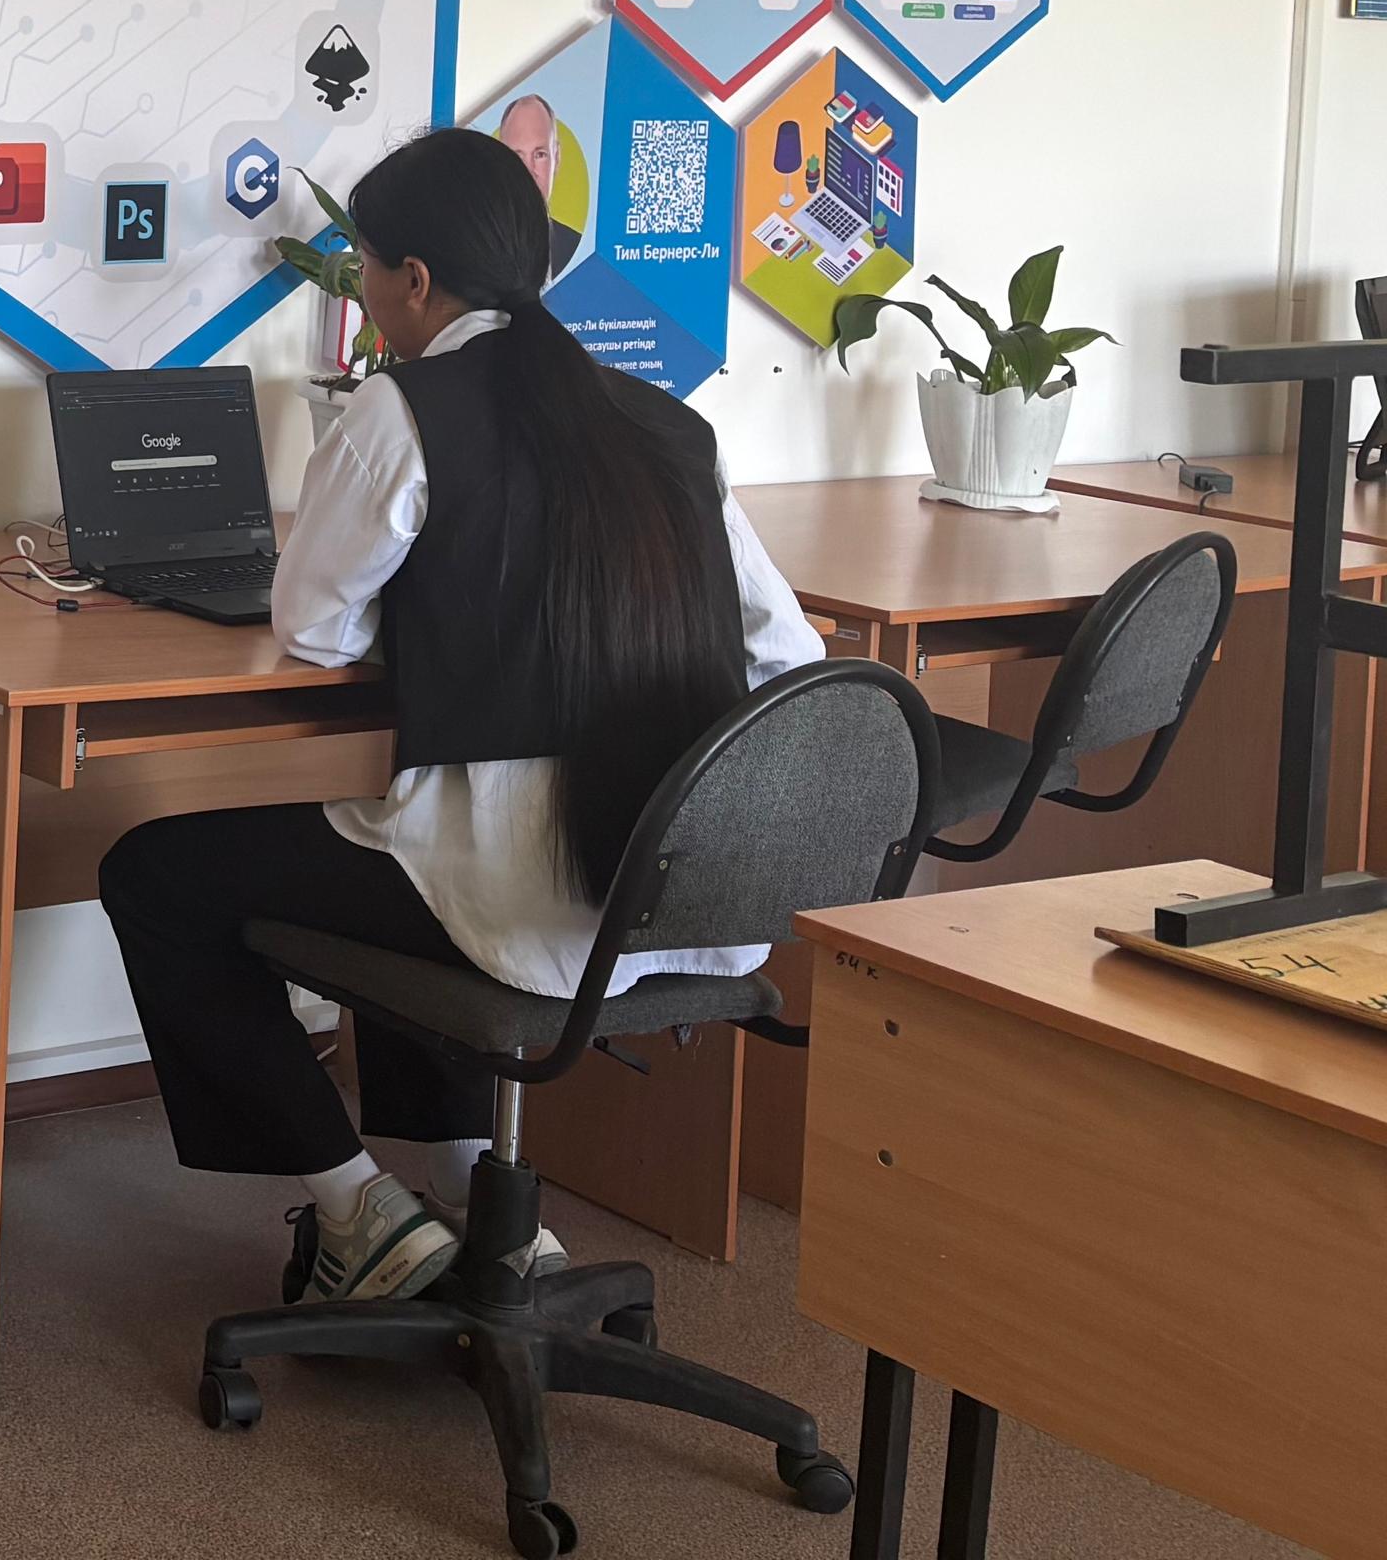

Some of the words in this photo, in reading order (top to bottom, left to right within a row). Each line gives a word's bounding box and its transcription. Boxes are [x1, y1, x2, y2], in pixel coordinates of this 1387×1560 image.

[235, 155, 277, 202] C++
[117, 198, 153, 241] Ps
[614, 244, 639, 261] Тим
[644, 244, 720, 262] Бернерс-Ли
[599, 317, 656, 332] бүкіләлемдік
[623, 338, 656, 352] ретінде
[639, 360, 663, 370] оның
[142, 432, 181, 450] Google
[1238, 953, 1341, 977] 54
